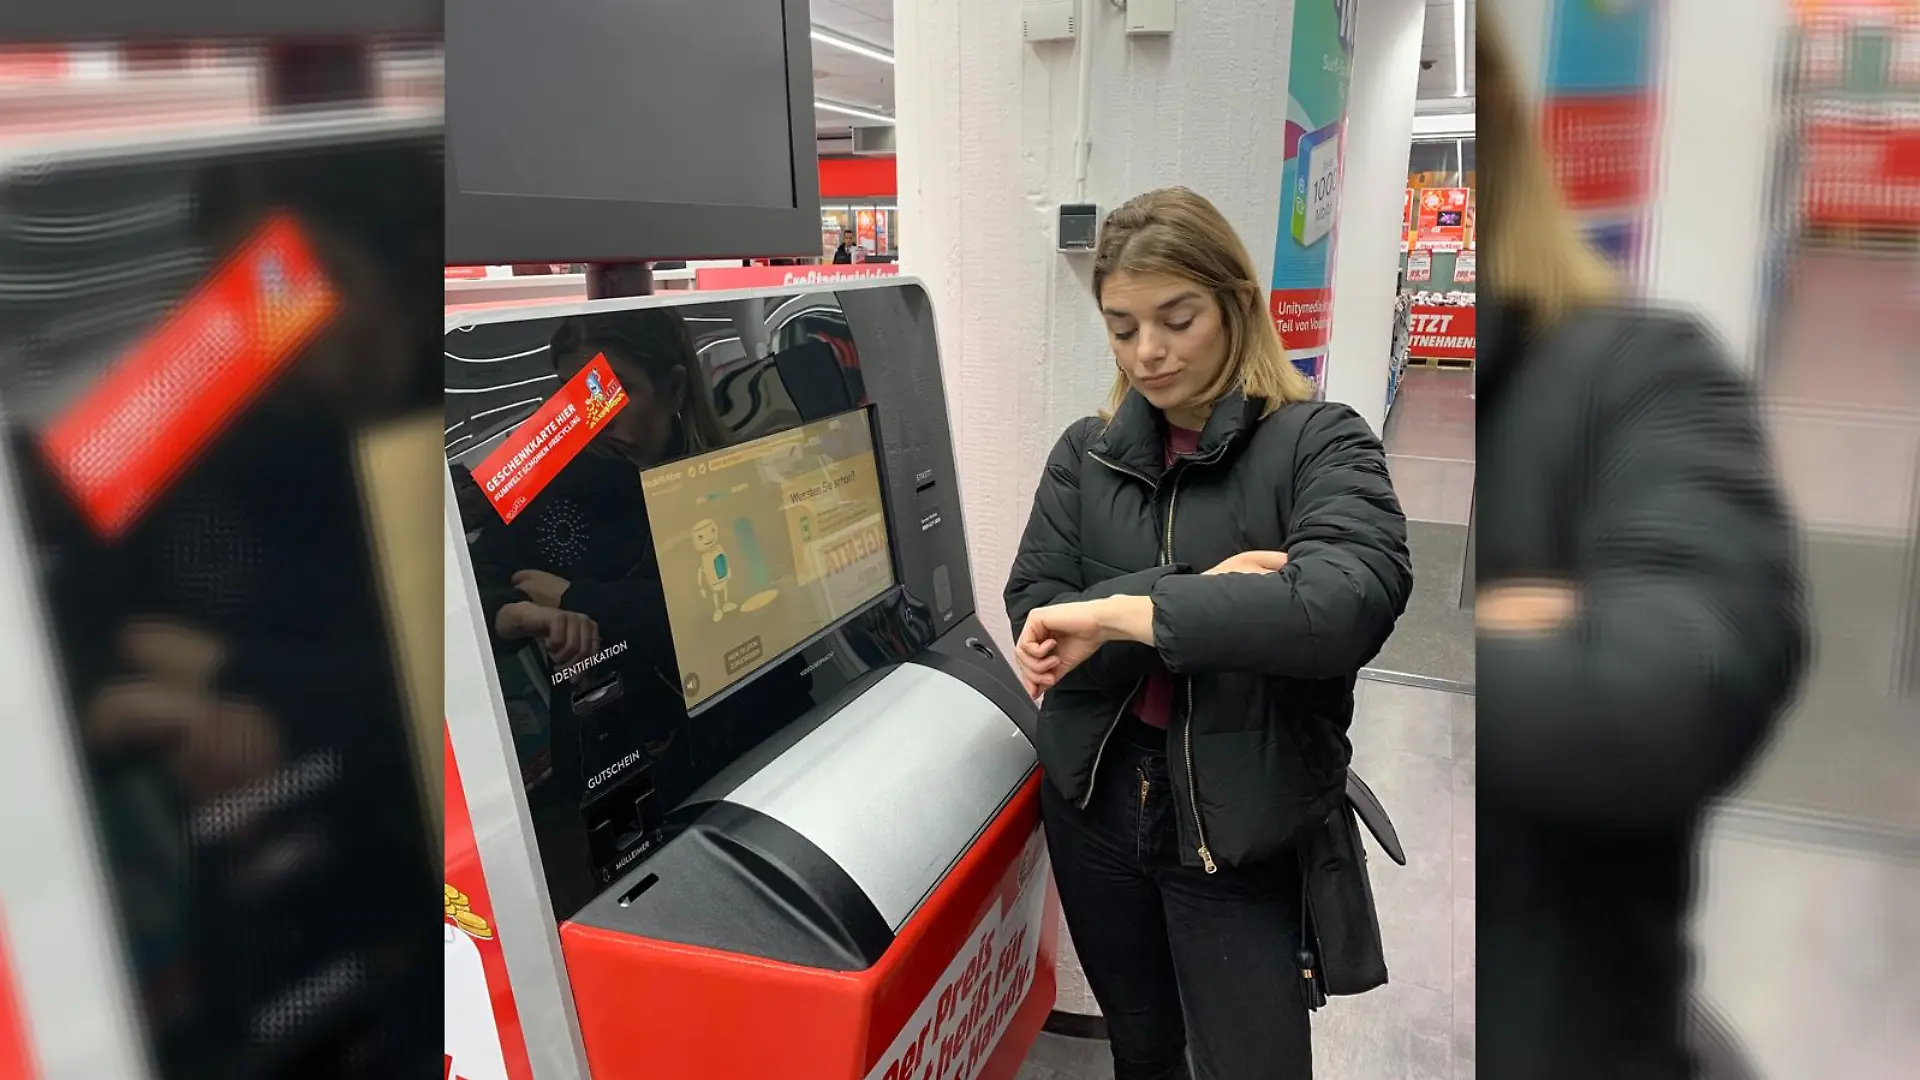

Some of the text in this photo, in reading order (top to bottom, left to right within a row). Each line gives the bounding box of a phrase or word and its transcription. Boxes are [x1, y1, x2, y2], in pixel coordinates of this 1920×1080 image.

[1277, 319, 1294, 332] Teil
[1295, 320, 1309, 331] von
[486, 403, 576, 492] GESCHENKKARTE HIER
[493, 415, 581, 502] #UMWELT SCHONEN #RECYCLING
[551, 640, 628, 686] IDENTIFIKATION
[587, 750, 640, 790] GUTSCHEIN
[615, 841, 651, 871] MÜLLEIMER
[932, 928, 996, 1046] Preis
[992, 922, 1028, 998] für
